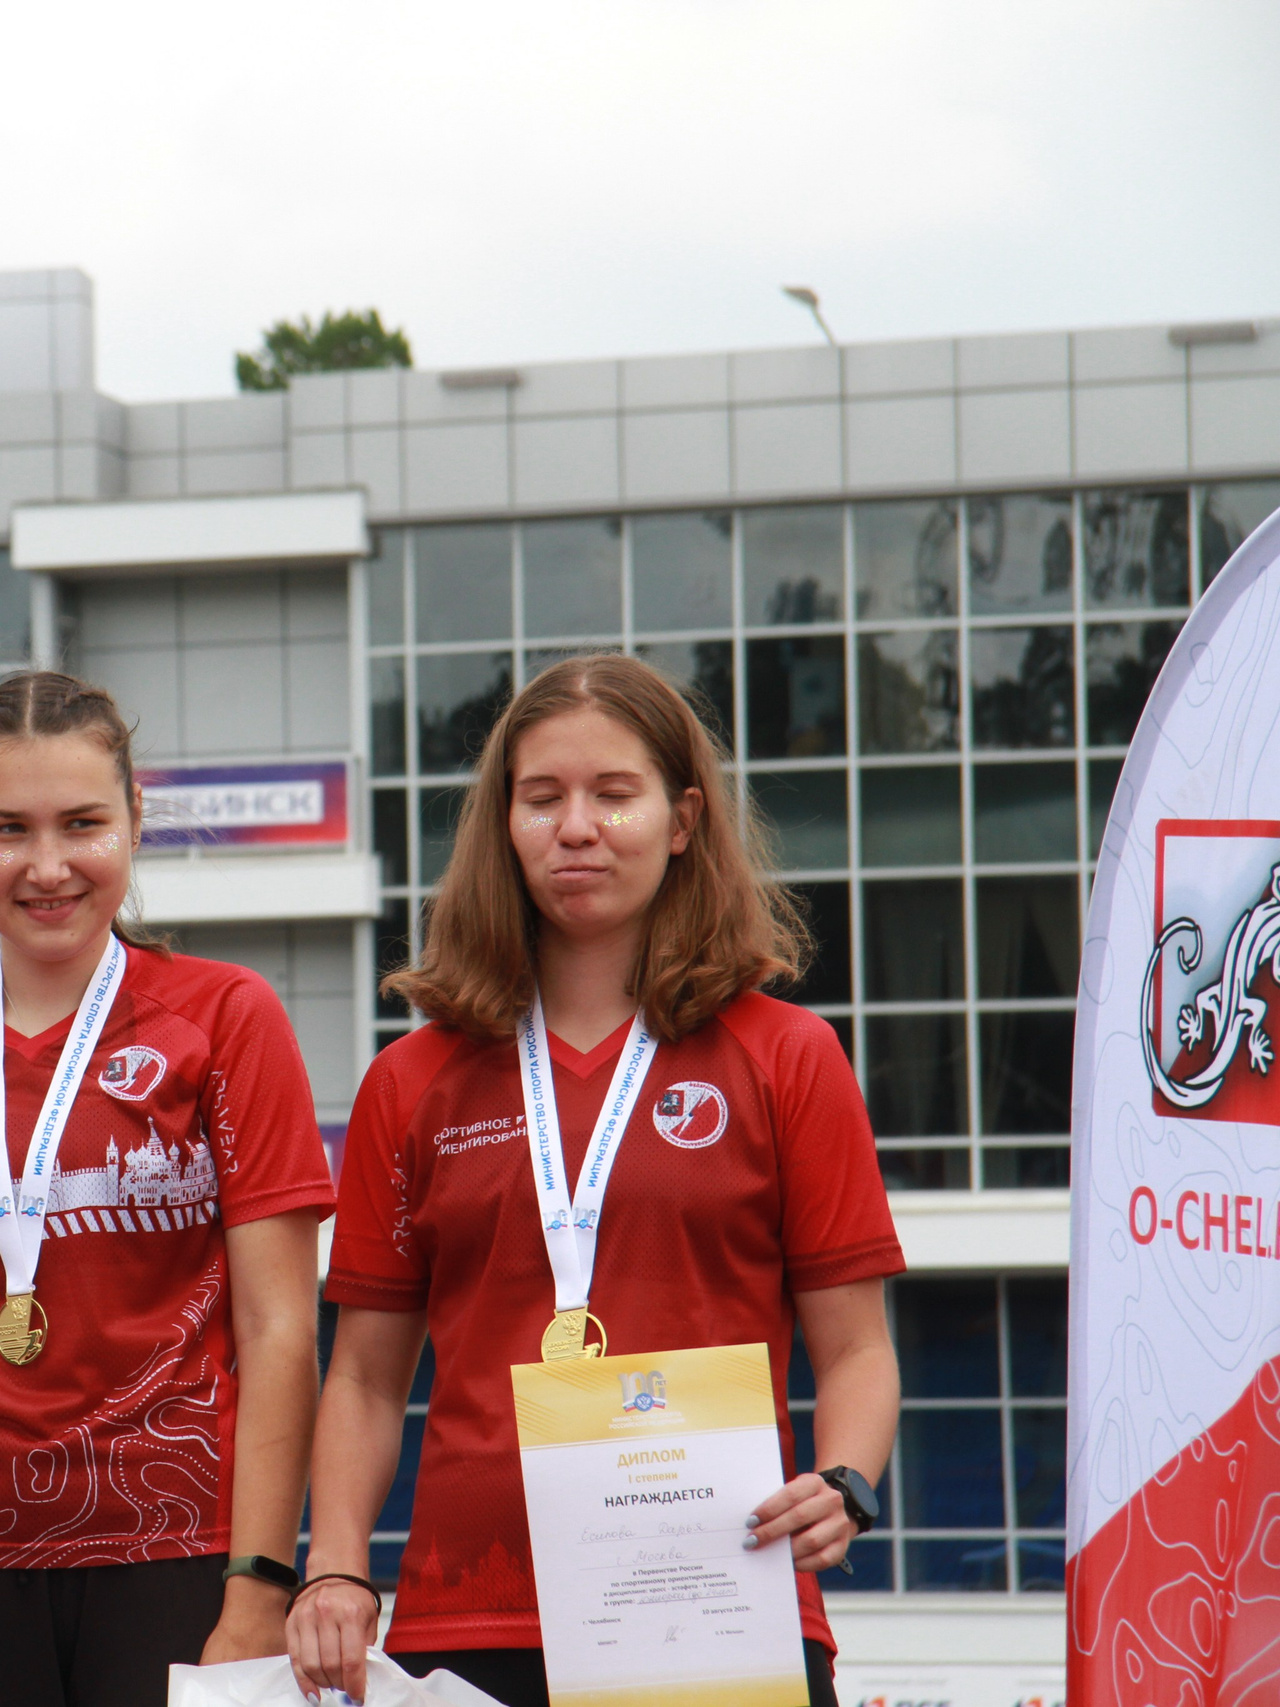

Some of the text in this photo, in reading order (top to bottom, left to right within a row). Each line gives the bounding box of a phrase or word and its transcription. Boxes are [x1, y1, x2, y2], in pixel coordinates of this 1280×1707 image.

[79, 1003, 100, 1040] СПОРТА
[54, 1042, 85, 1107] РОССИЙСКОЙ
[530, 1060, 543, 1100] СПОРТА
[611, 1046, 645, 1116] РОССИЙСКОЙ
[33, 1108, 59, 1176] ФЕДЕРАЦИИ
[434, 1117, 511, 1145] СОРТИВНОЕ
[437, 1126, 528, 1156] ИЕНТИРОВАН
[535, 1103, 555, 1190] МИНИСТЕРСТВО
[588, 1118, 617, 1188] ФЕДЕРАЦИИ
[1129, 1185, 1280, 1260] O-CHEL.
[617, 1448, 687, 1468] ДИПЛОМ
[635, 1472, 678, 1483] степени
[604, 1487, 714, 1508] НАГРАЖДАЕТСЯ
[633, 1546, 689, 1564] Москва
[621, 1577, 666, 1588] спортивному
[667, 1571, 727, 1583] ориентированию
[638, 1567, 678, 1576] Первенстве
[679, 1564, 703, 1572] России
[649, 1586, 666, 1594] кросс
[707, 1580, 737, 1588] человека
[609, 1598, 635, 1607] группе:
